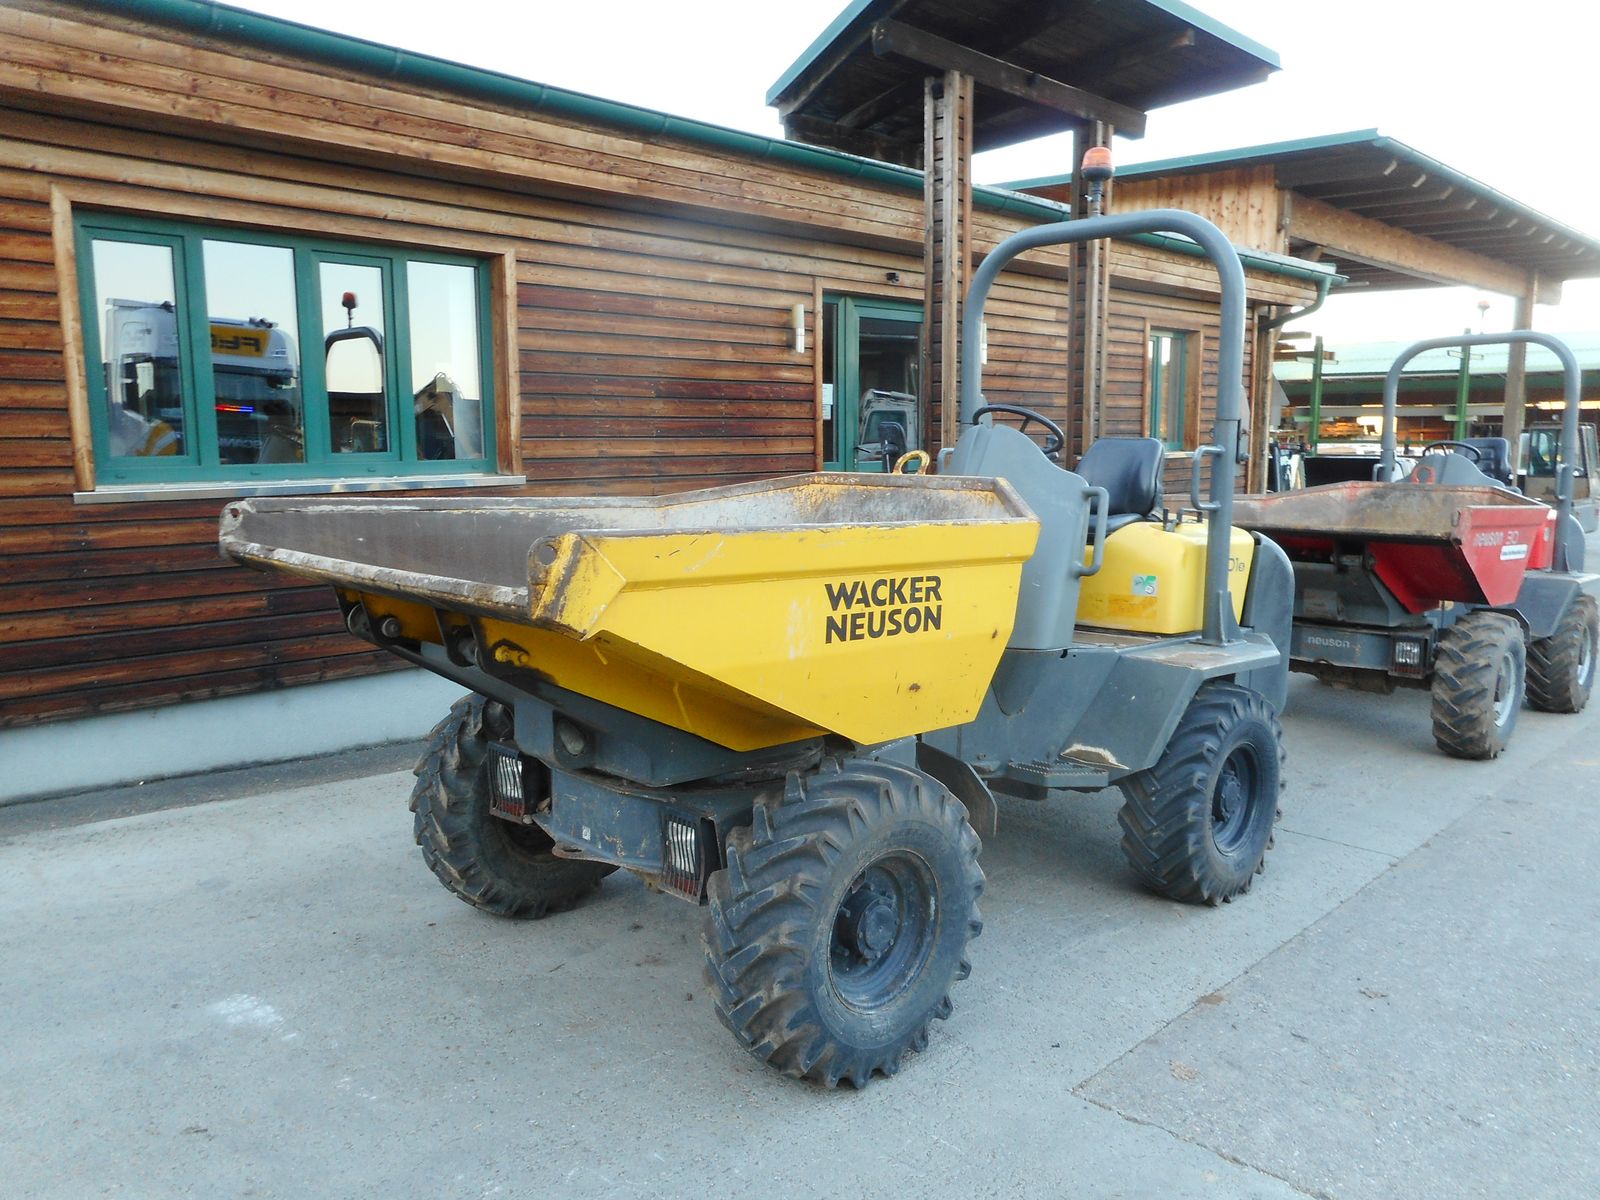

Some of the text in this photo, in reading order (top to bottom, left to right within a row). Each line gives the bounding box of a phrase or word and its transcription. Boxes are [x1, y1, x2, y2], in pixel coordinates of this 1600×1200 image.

[824, 575, 942, 612] WACKER
[825, 604, 942, 644] NEUSON
[1307, 634, 1350, 649] neuson
